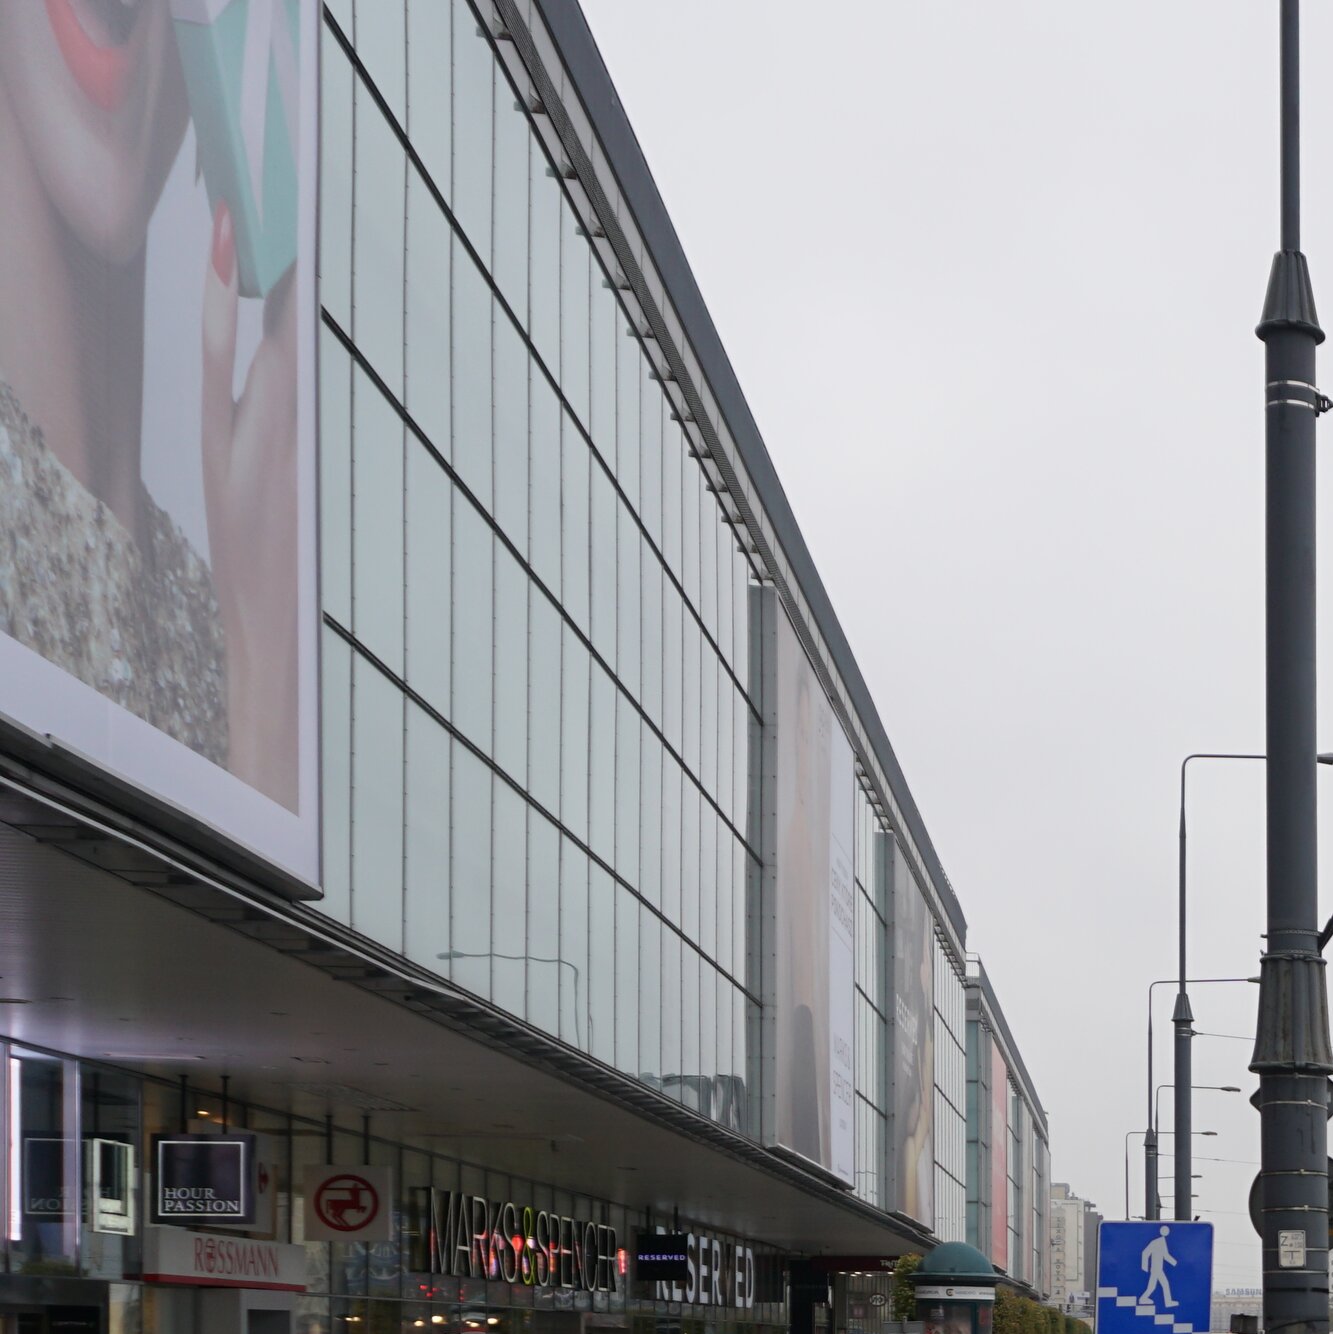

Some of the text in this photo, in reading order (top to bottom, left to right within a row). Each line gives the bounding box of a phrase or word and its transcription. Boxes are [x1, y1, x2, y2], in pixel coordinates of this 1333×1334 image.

[164, 1187, 216, 1200] HOUR
[164, 1199, 239, 1212] PASSION
[194, 1236, 280, 1278] ROSSMANN
[638, 1253, 686, 1262] RESERVED
[1225, 1288, 1262, 1297] SAMSUN
